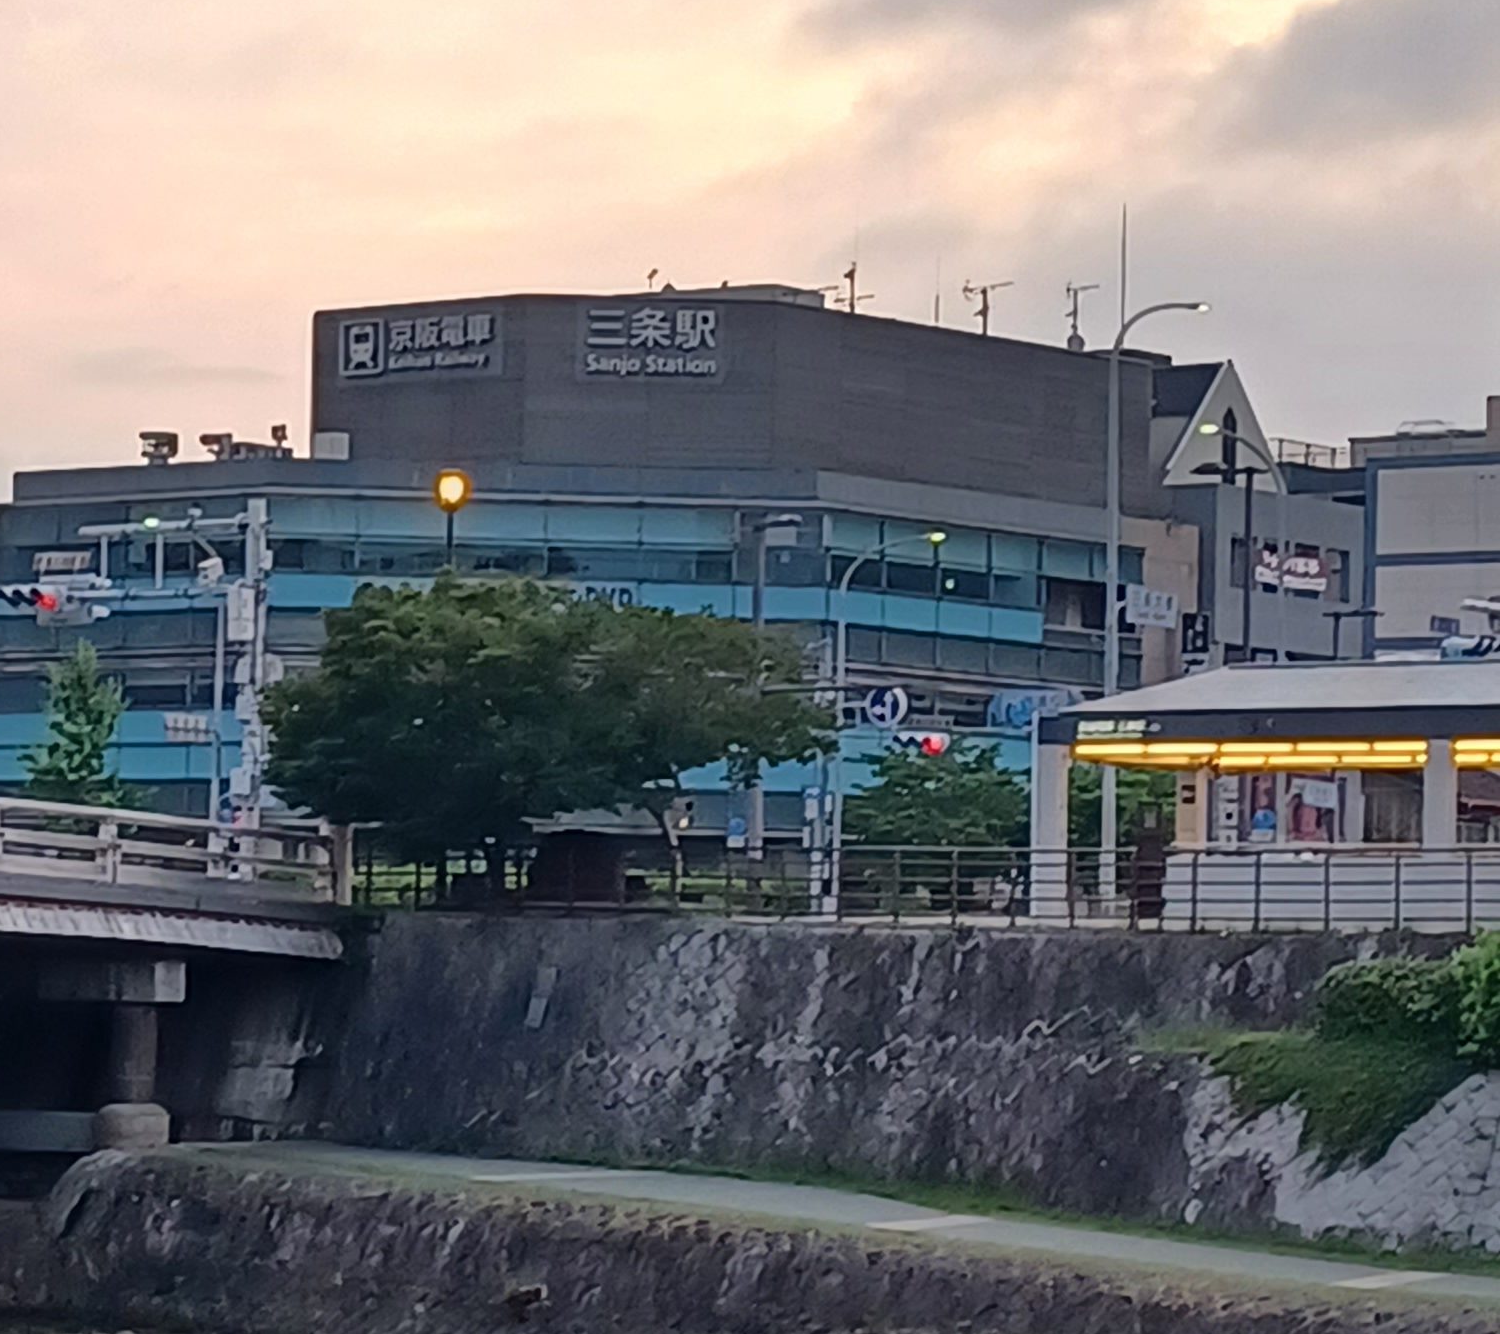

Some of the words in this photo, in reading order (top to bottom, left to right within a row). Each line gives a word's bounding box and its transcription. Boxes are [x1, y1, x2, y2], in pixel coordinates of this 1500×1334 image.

[388, 314, 493, 352] 京阪電車
[587, 307, 716, 349] 三条駅
[586, 353, 640, 376] Sanjo
[645, 354, 717, 374] Station
